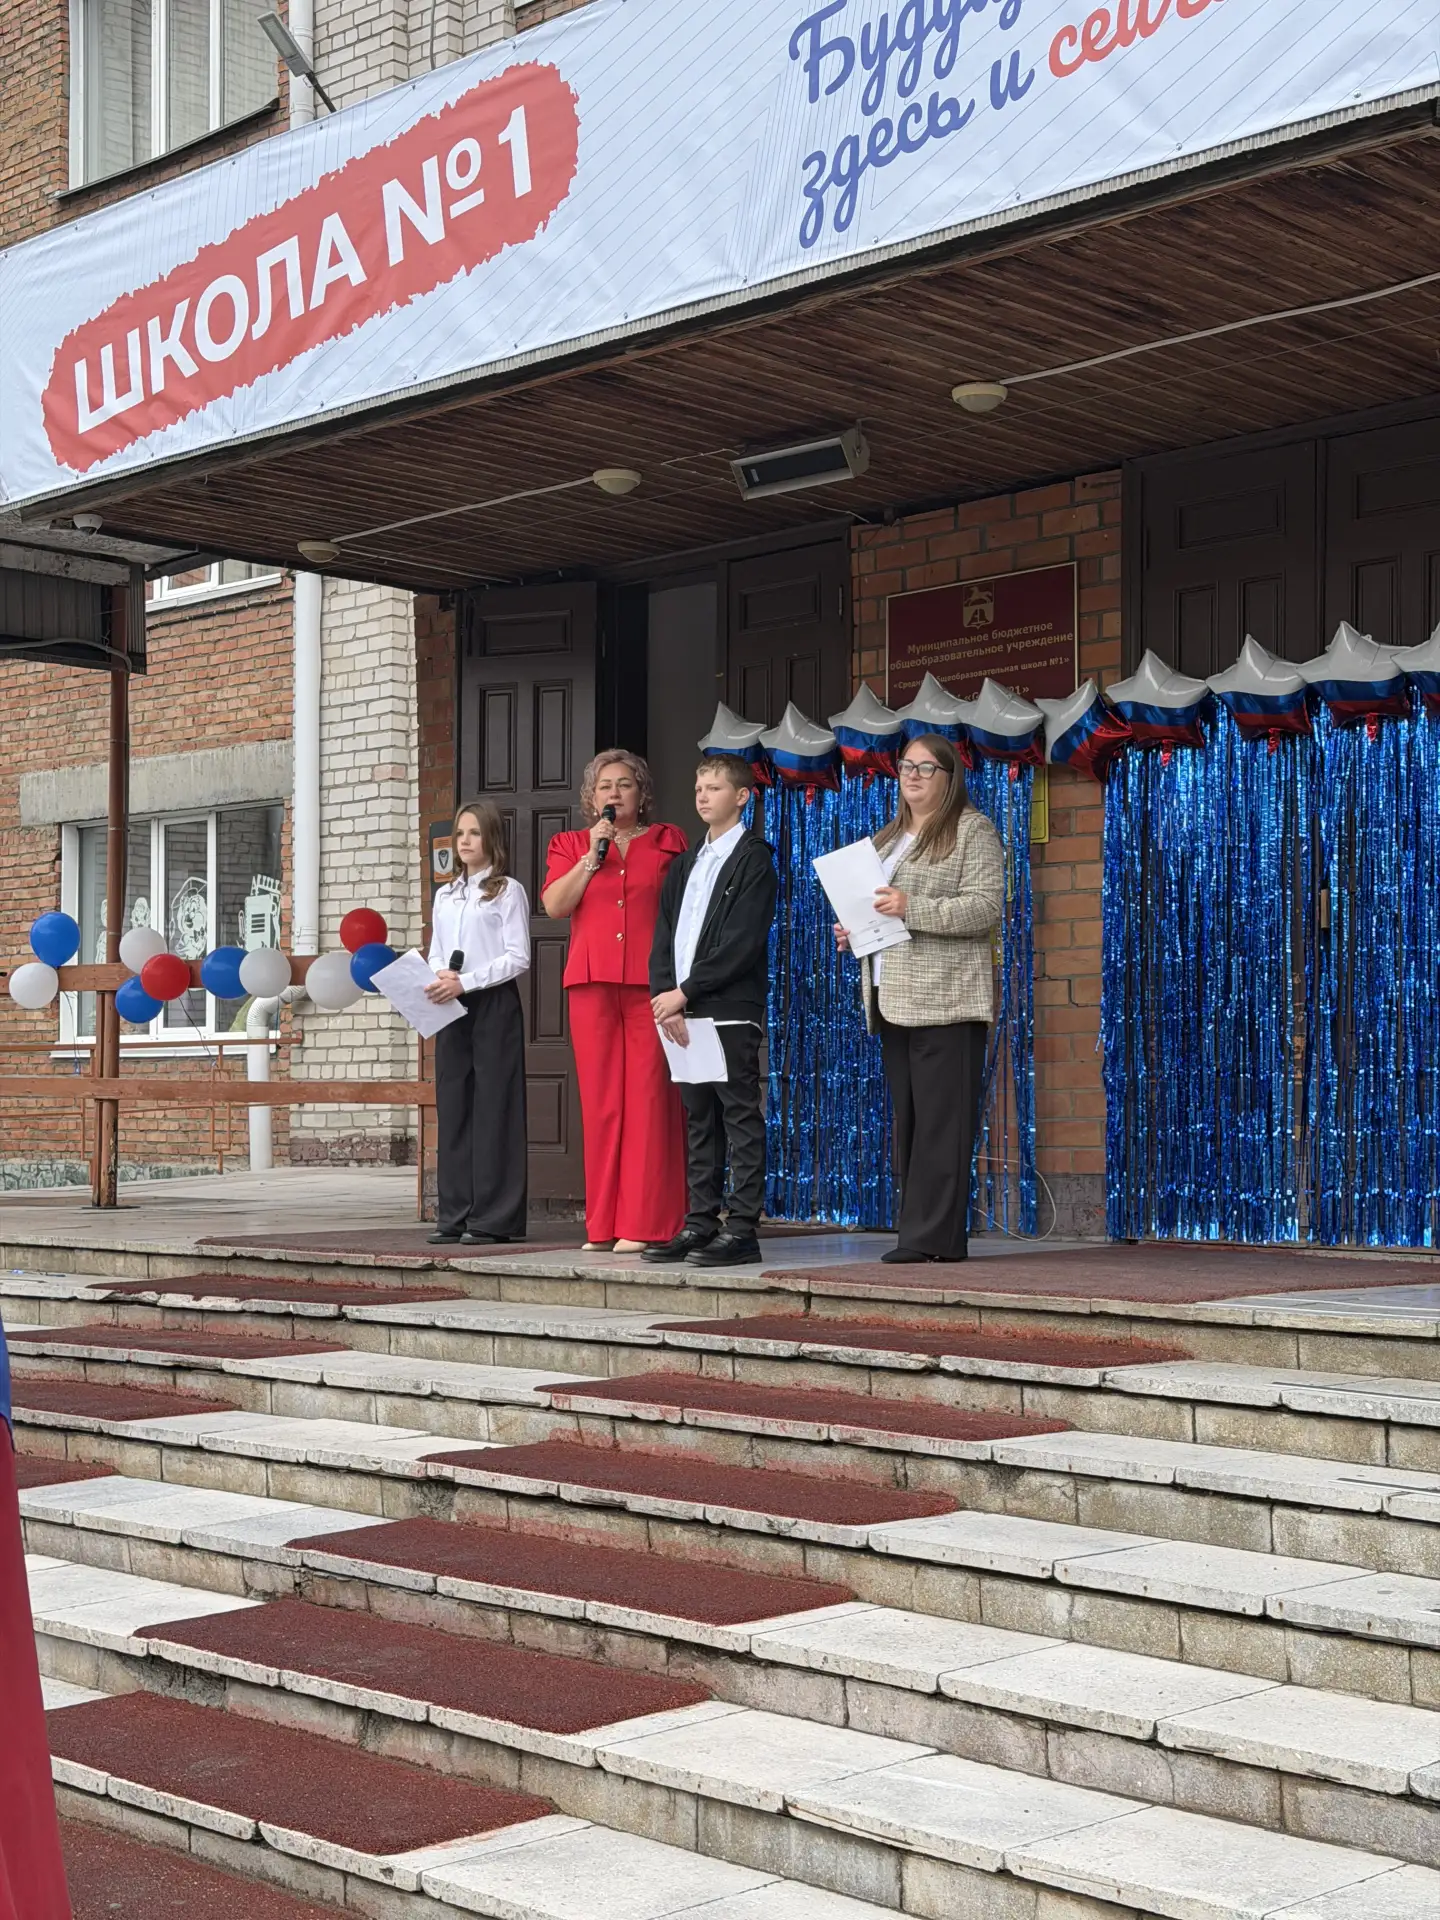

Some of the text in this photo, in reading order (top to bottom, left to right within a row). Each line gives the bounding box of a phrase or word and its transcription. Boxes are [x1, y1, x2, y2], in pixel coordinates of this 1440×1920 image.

[799, 92, 976, 249] здесь
[989, 51, 1035, 110] и
[74, 211, 367, 435] ШКОЛА
[889, 632, 1074, 671] общеобразовательное учреждение
[907, 622, 1053, 655] Муниципальное бюджетное
[935, 664, 1019, 683] бщеобразовательная
[1020, 660, 1048, 670] школа
